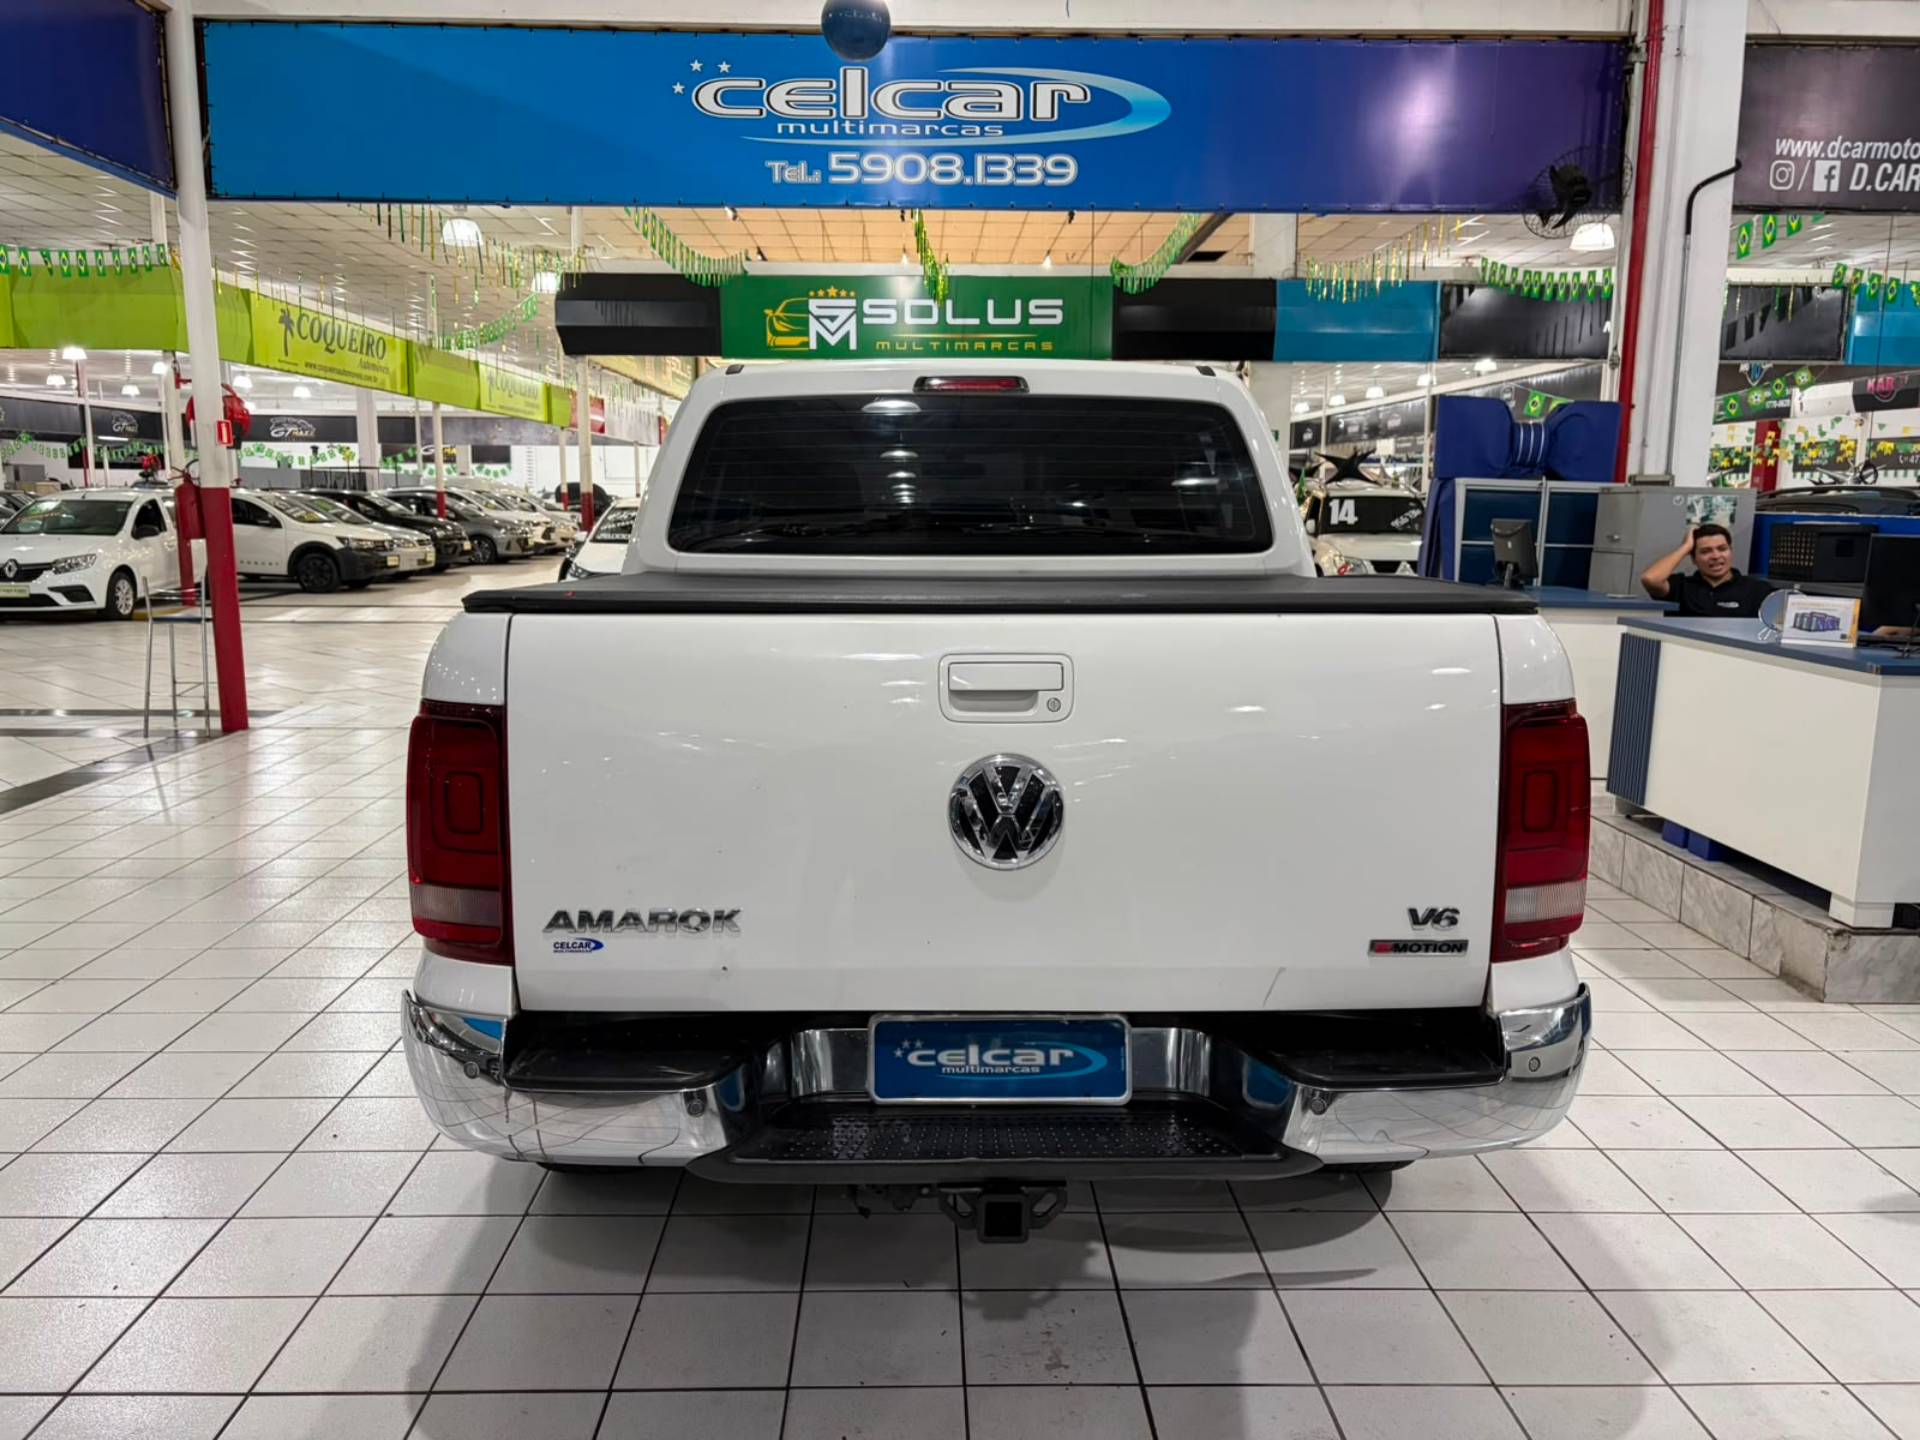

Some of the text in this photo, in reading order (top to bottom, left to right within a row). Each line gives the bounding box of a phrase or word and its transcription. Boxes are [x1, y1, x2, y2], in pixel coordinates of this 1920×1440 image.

[692, 66, 1091, 122] celcar
[777, 120, 1004, 136] multimarcas
[828, 151, 1079, 186] 5908.1339
[862, 298, 1064, 325] SOLUS
[297, 312, 387, 361] COQUEIRO
[875, 341, 1054, 351] MULTIMARCAS
[1329, 498, 1358, 526] 14
[542, 908, 742, 934] AMAROK
[1407, 906, 1461, 931] V6
[552, 941, 592, 950] CELCAR
[907, 1044, 1074, 1067] celcar
[941, 1065, 1041, 1074] multimarcas
